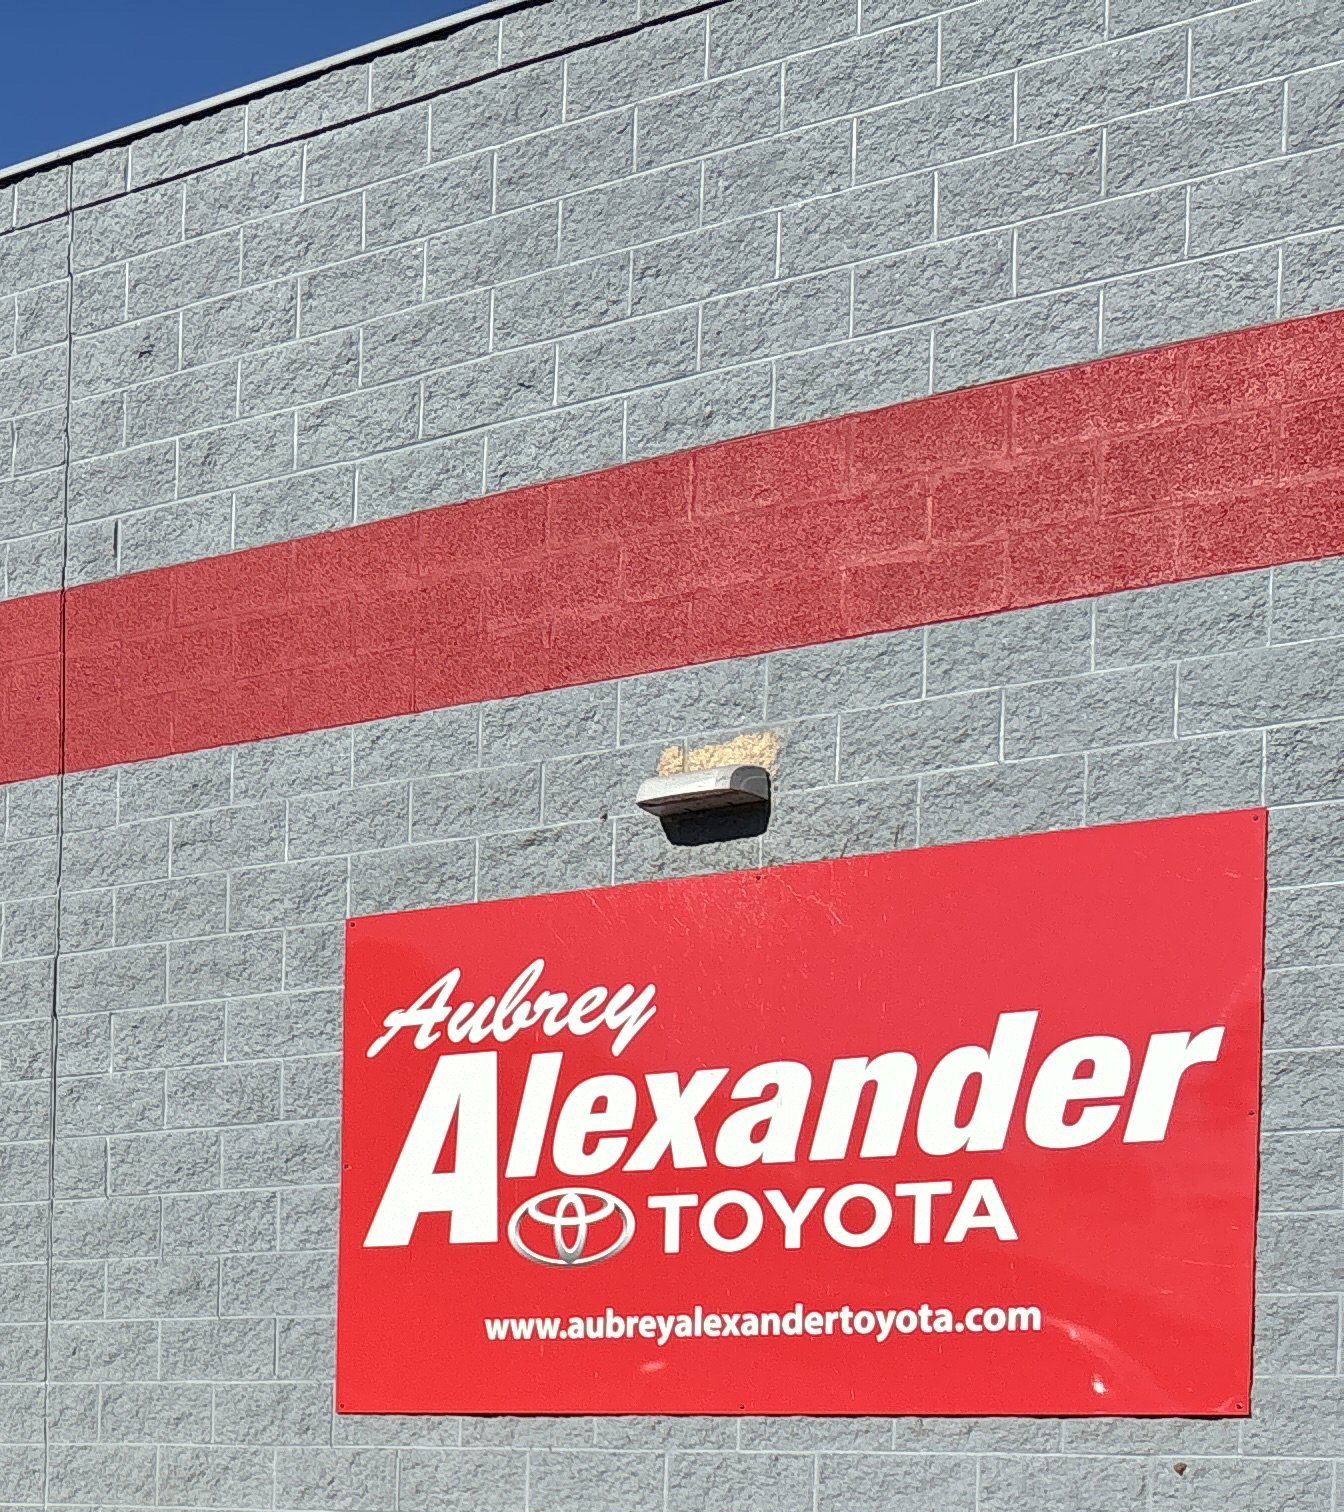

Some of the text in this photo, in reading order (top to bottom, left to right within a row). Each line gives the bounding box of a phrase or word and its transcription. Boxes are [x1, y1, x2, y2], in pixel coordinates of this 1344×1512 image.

[367, 958, 657, 1057] Aubrey
[362, 1010, 1226, 1248] Alexander
[647, 1178, 1019, 1254] TOYOTA
[484, 1303, 1042, 1345] www.aubreyalexandertoyota.com
